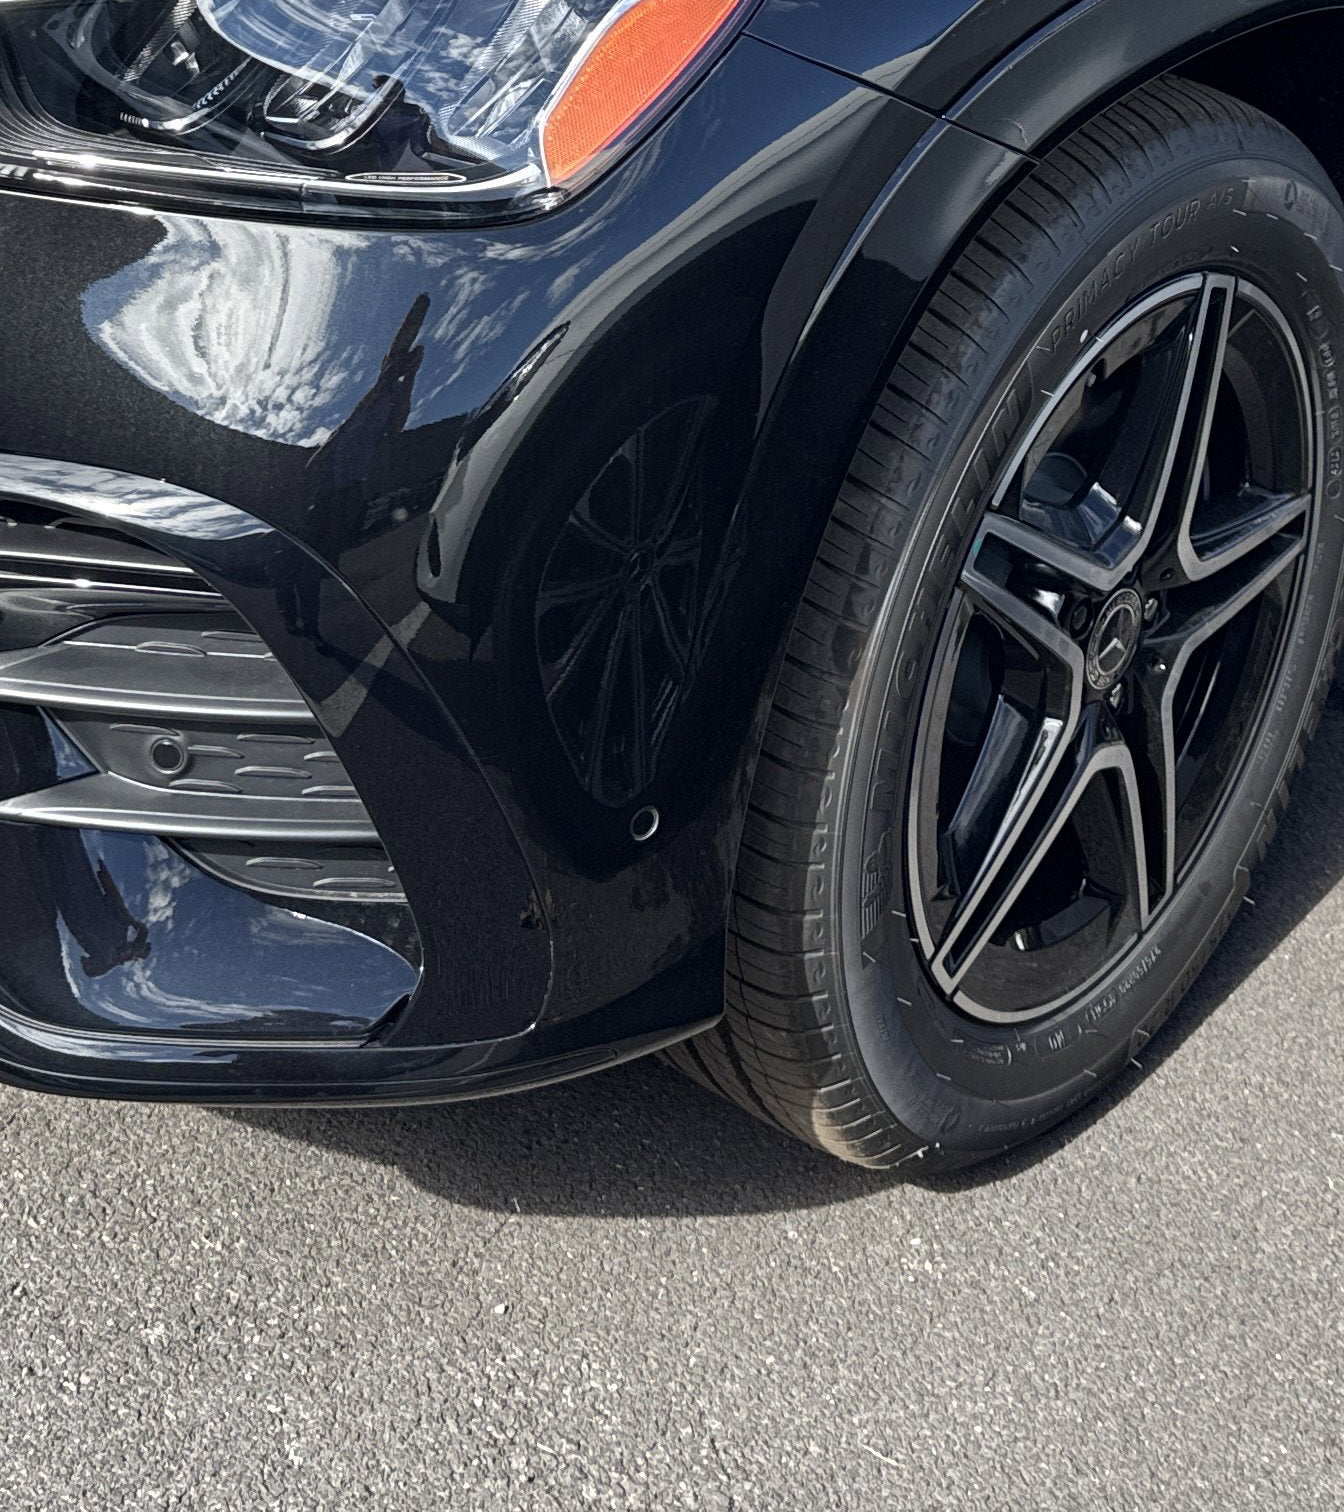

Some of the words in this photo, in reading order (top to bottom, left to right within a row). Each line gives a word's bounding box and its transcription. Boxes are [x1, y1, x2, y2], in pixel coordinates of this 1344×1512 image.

[1049, 236, 1142, 354] PRIMACY
[1149, 198, 1202, 247] TOUR
[869, 386, 1024, 812] MICHELIN
